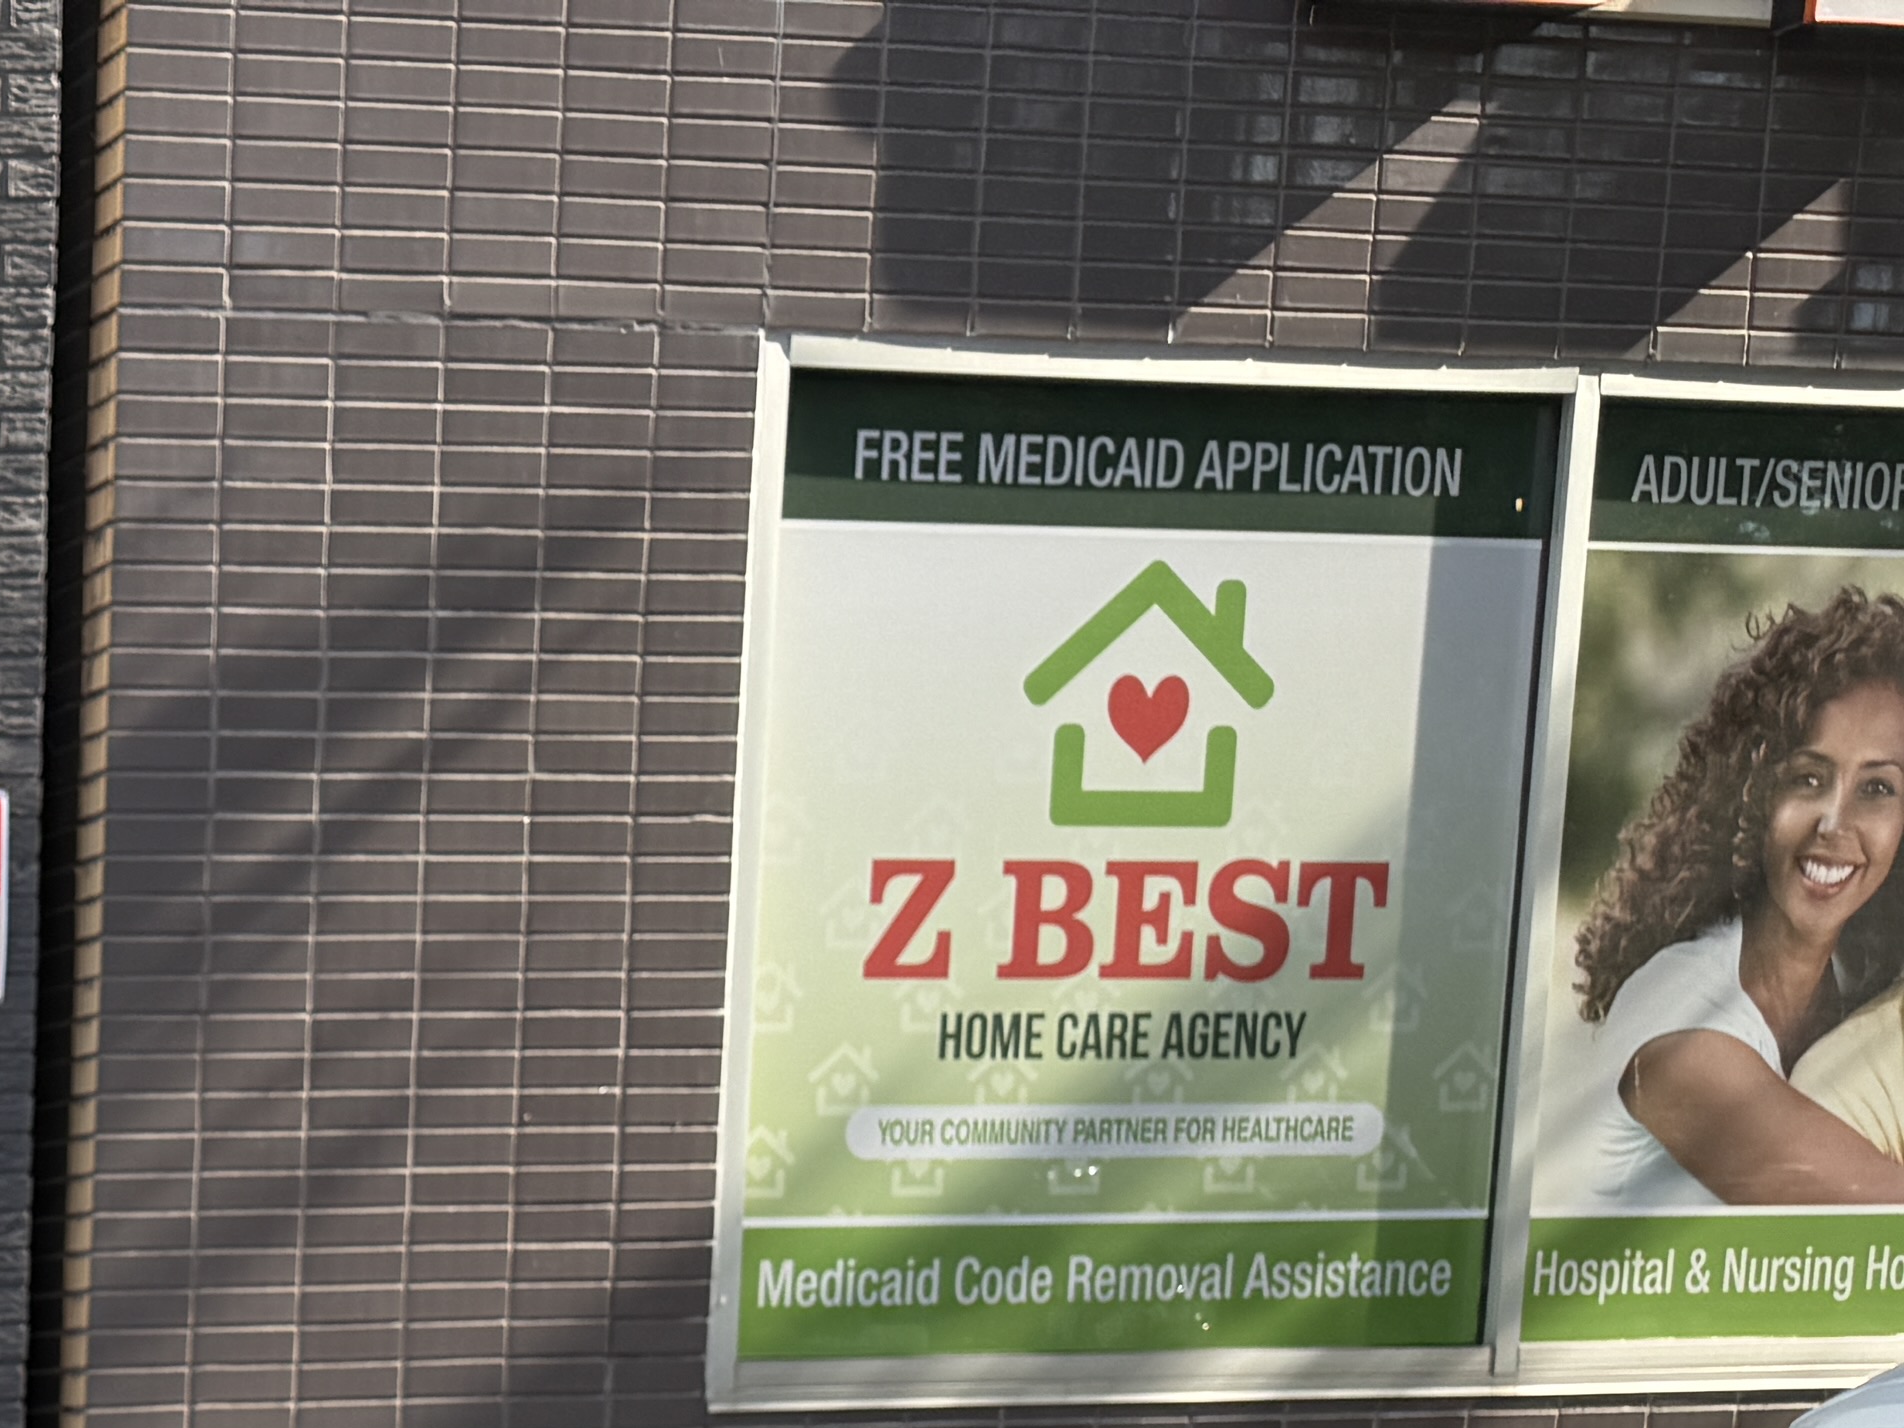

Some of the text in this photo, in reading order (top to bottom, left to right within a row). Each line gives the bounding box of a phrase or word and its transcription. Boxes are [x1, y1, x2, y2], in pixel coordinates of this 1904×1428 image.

[853, 428, 1463, 498] FREE MEDICAID APPLICATION
[861, 858, 1390, 983] Z BEST
[938, 1010, 1307, 1060] HOME CARE AGENCY
[877, 1115, 1355, 1146] YOUR COMMUNITY PARTNER FOR HEALTHCARE
[756, 1250, 1452, 1310] Medicaid Code Removal Assistance
[1532, 1247, 1675, 1306] Hospital
[1684, 1247, 1712, 1294] &
[1721, 1245, 1856, 1302] Nursing
